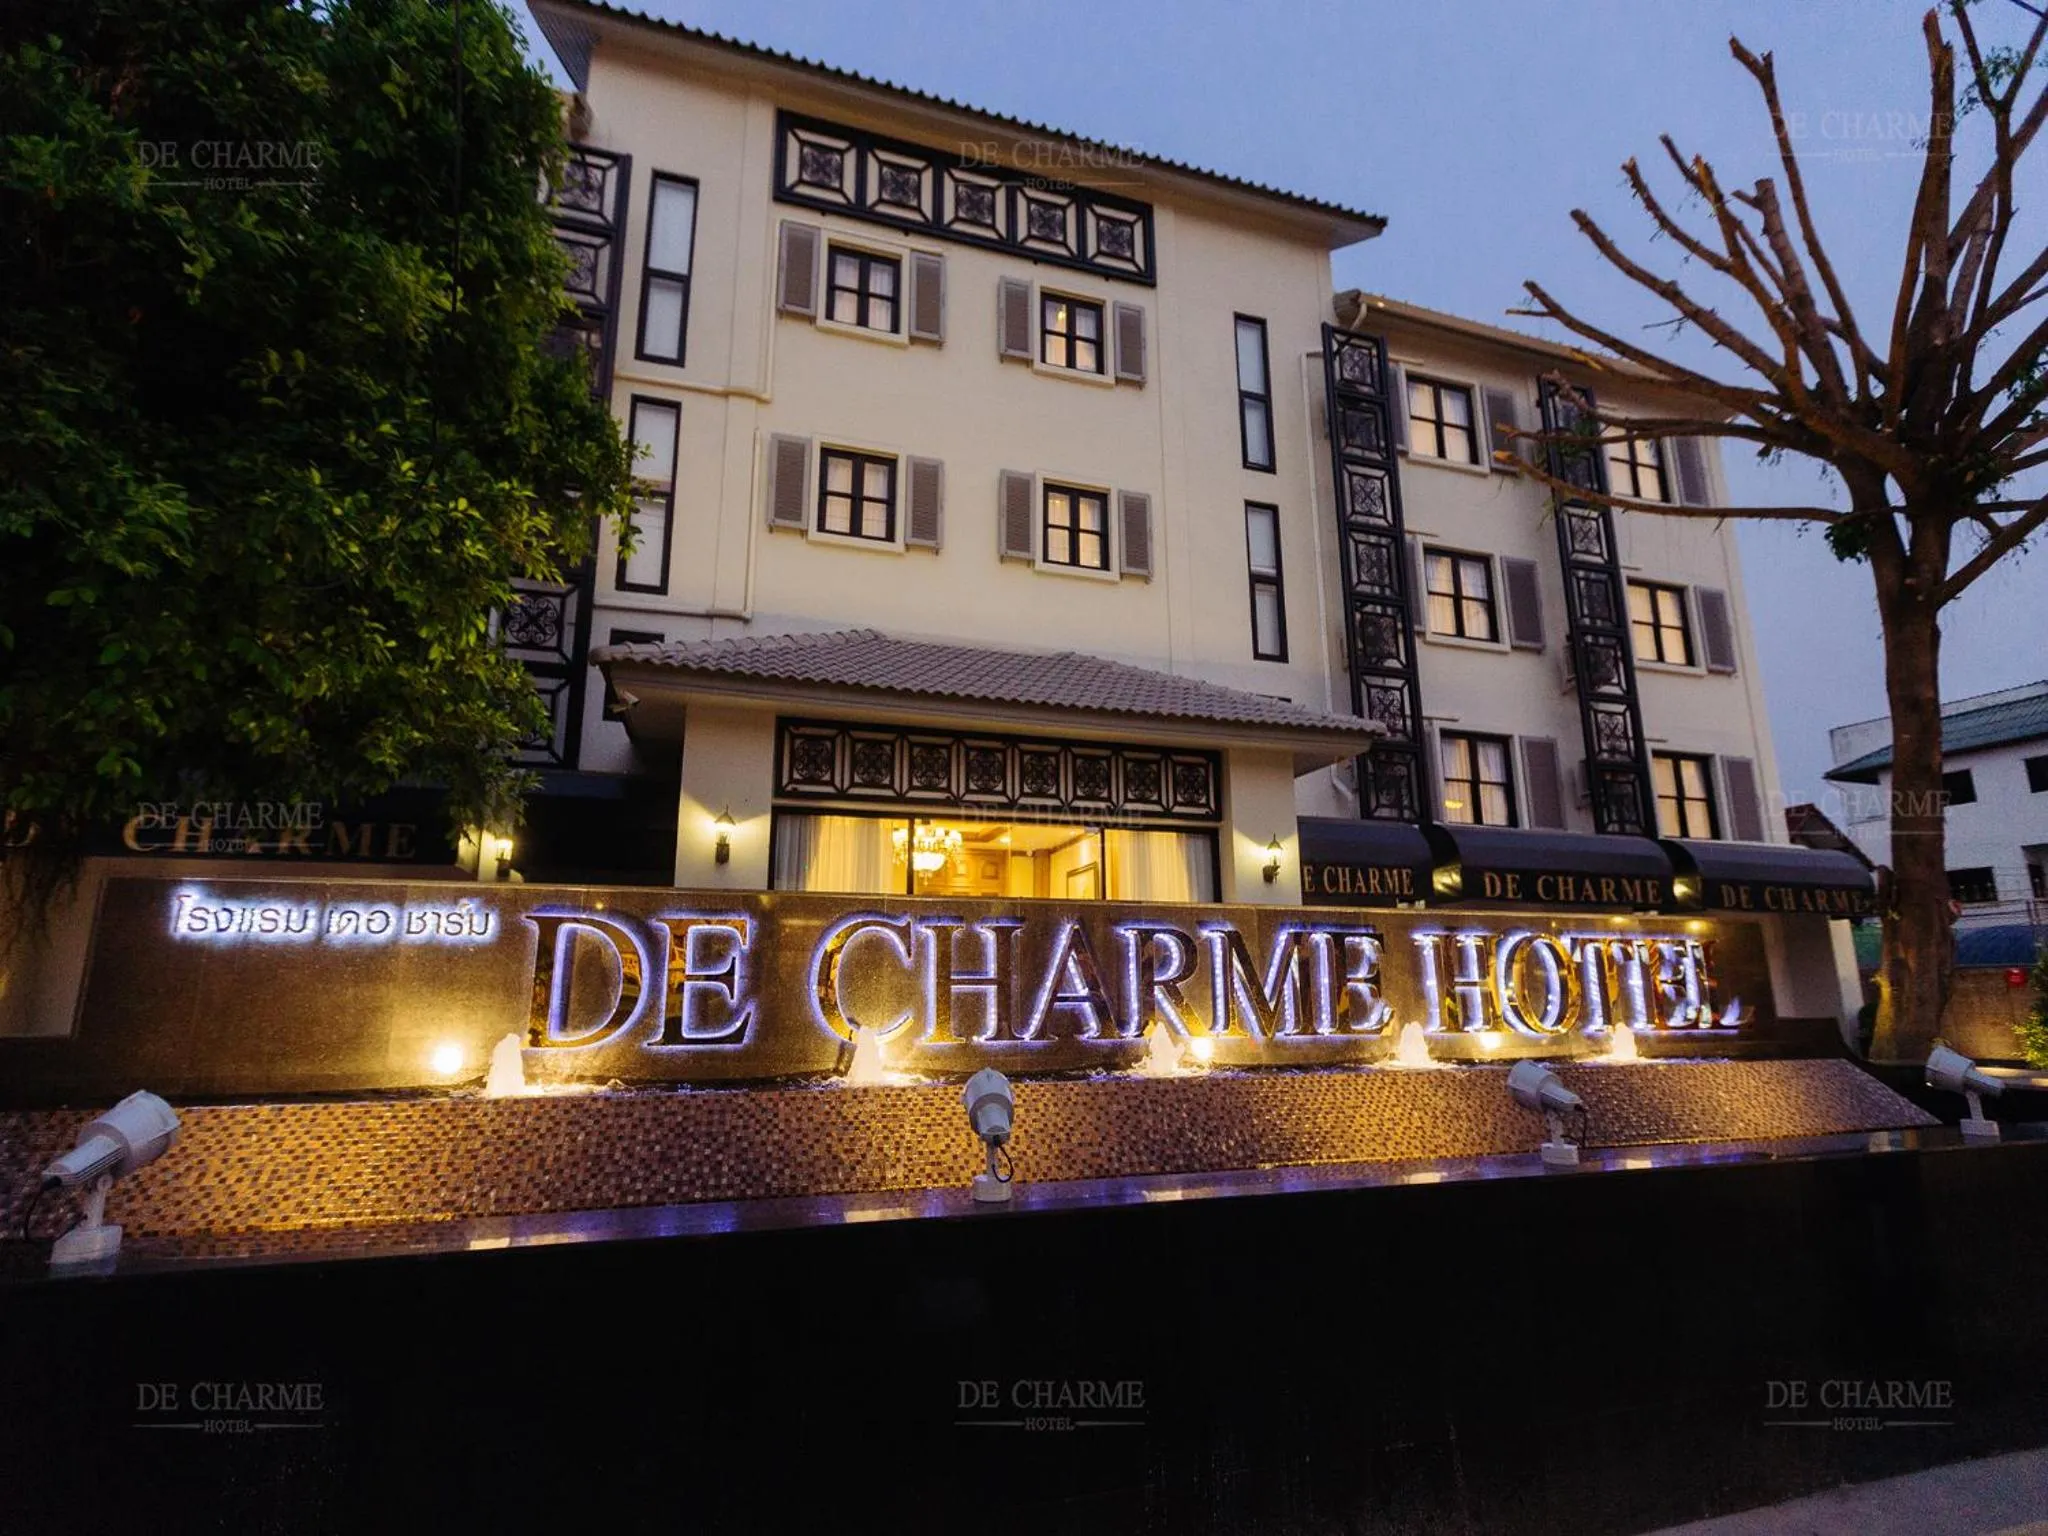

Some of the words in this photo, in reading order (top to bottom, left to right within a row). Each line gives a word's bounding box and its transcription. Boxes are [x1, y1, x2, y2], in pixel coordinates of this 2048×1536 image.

[1302, 866, 1316, 893] E
[1322, 866, 1415, 896] CHARME
[1483, 872, 1523, 900] DE
[1536, 874, 1664, 905] CHARME
[173, 892, 310, 935] โรงแรม
[325, 906, 391, 936] เดอ
[405, 898, 491, 938] ชาร์ม
[1720, 884, 1754, 910] DE
[1763, 885, 1866, 914] CHARME
[524, 910, 758, 1049] DE
[806, 911, 1391, 1047] CHARME
[1412, 927, 1756, 1038] HOTEL
